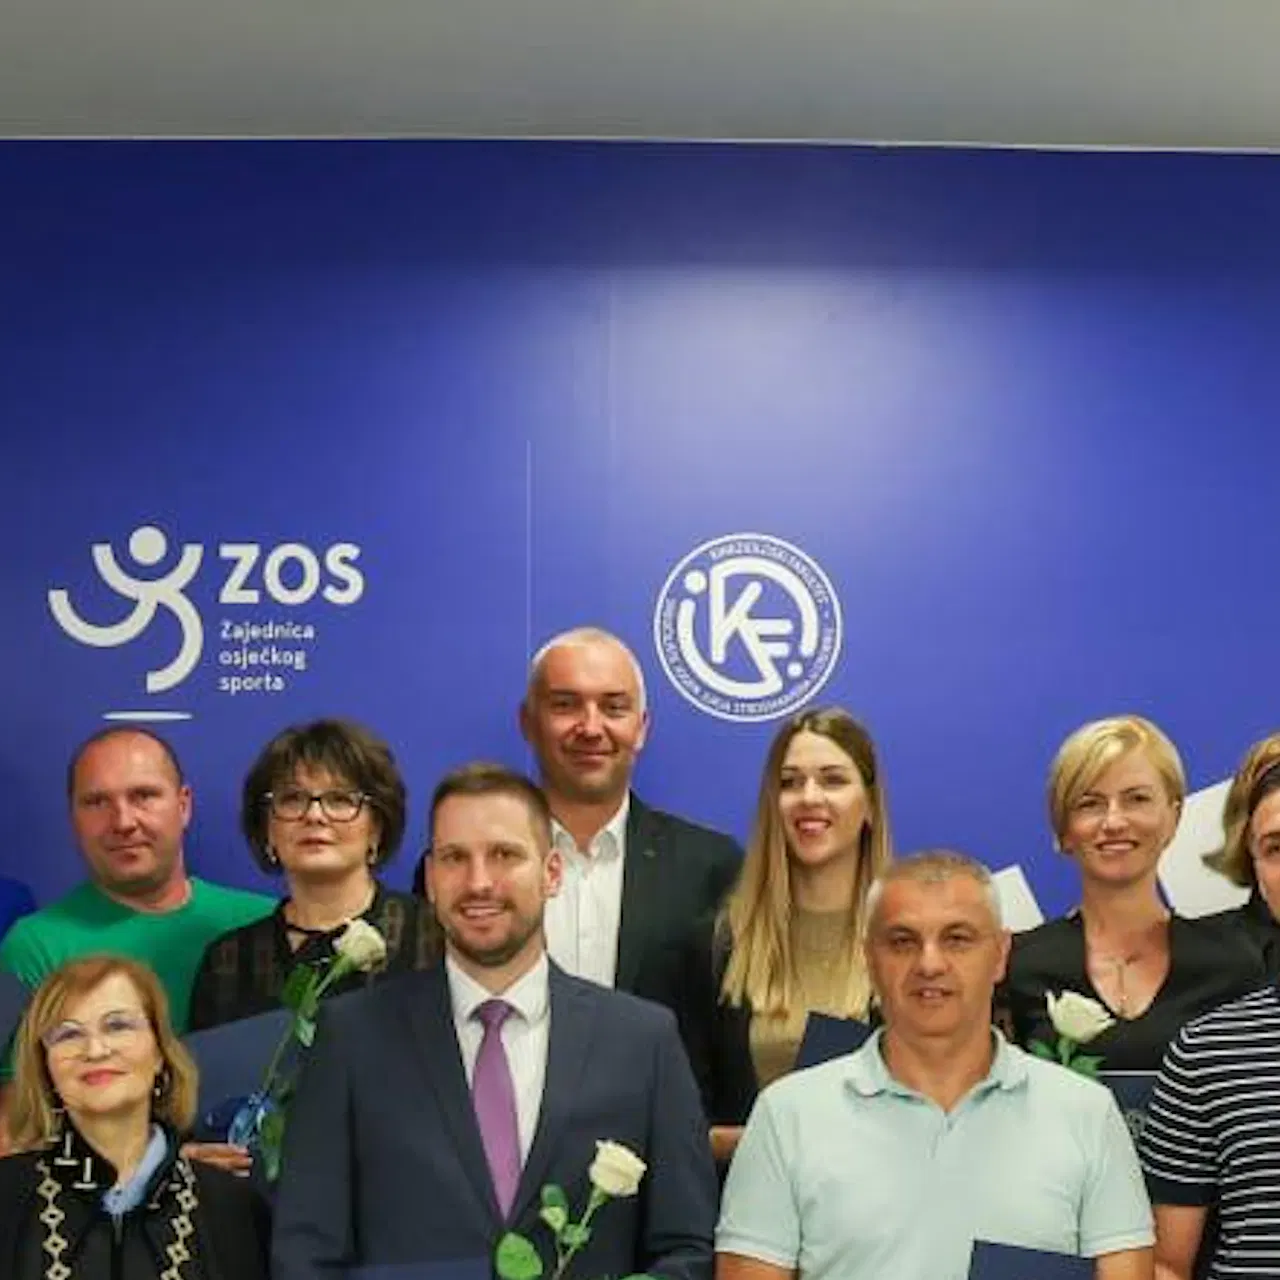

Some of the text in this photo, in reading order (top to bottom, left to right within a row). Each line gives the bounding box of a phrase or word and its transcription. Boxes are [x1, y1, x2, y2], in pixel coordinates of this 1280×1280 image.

[219, 543, 365, 604] ZOS
[221, 620, 315, 643] Zajednica
[219, 646, 307, 671] osječkog
[219, 673, 285, 696] sporta
